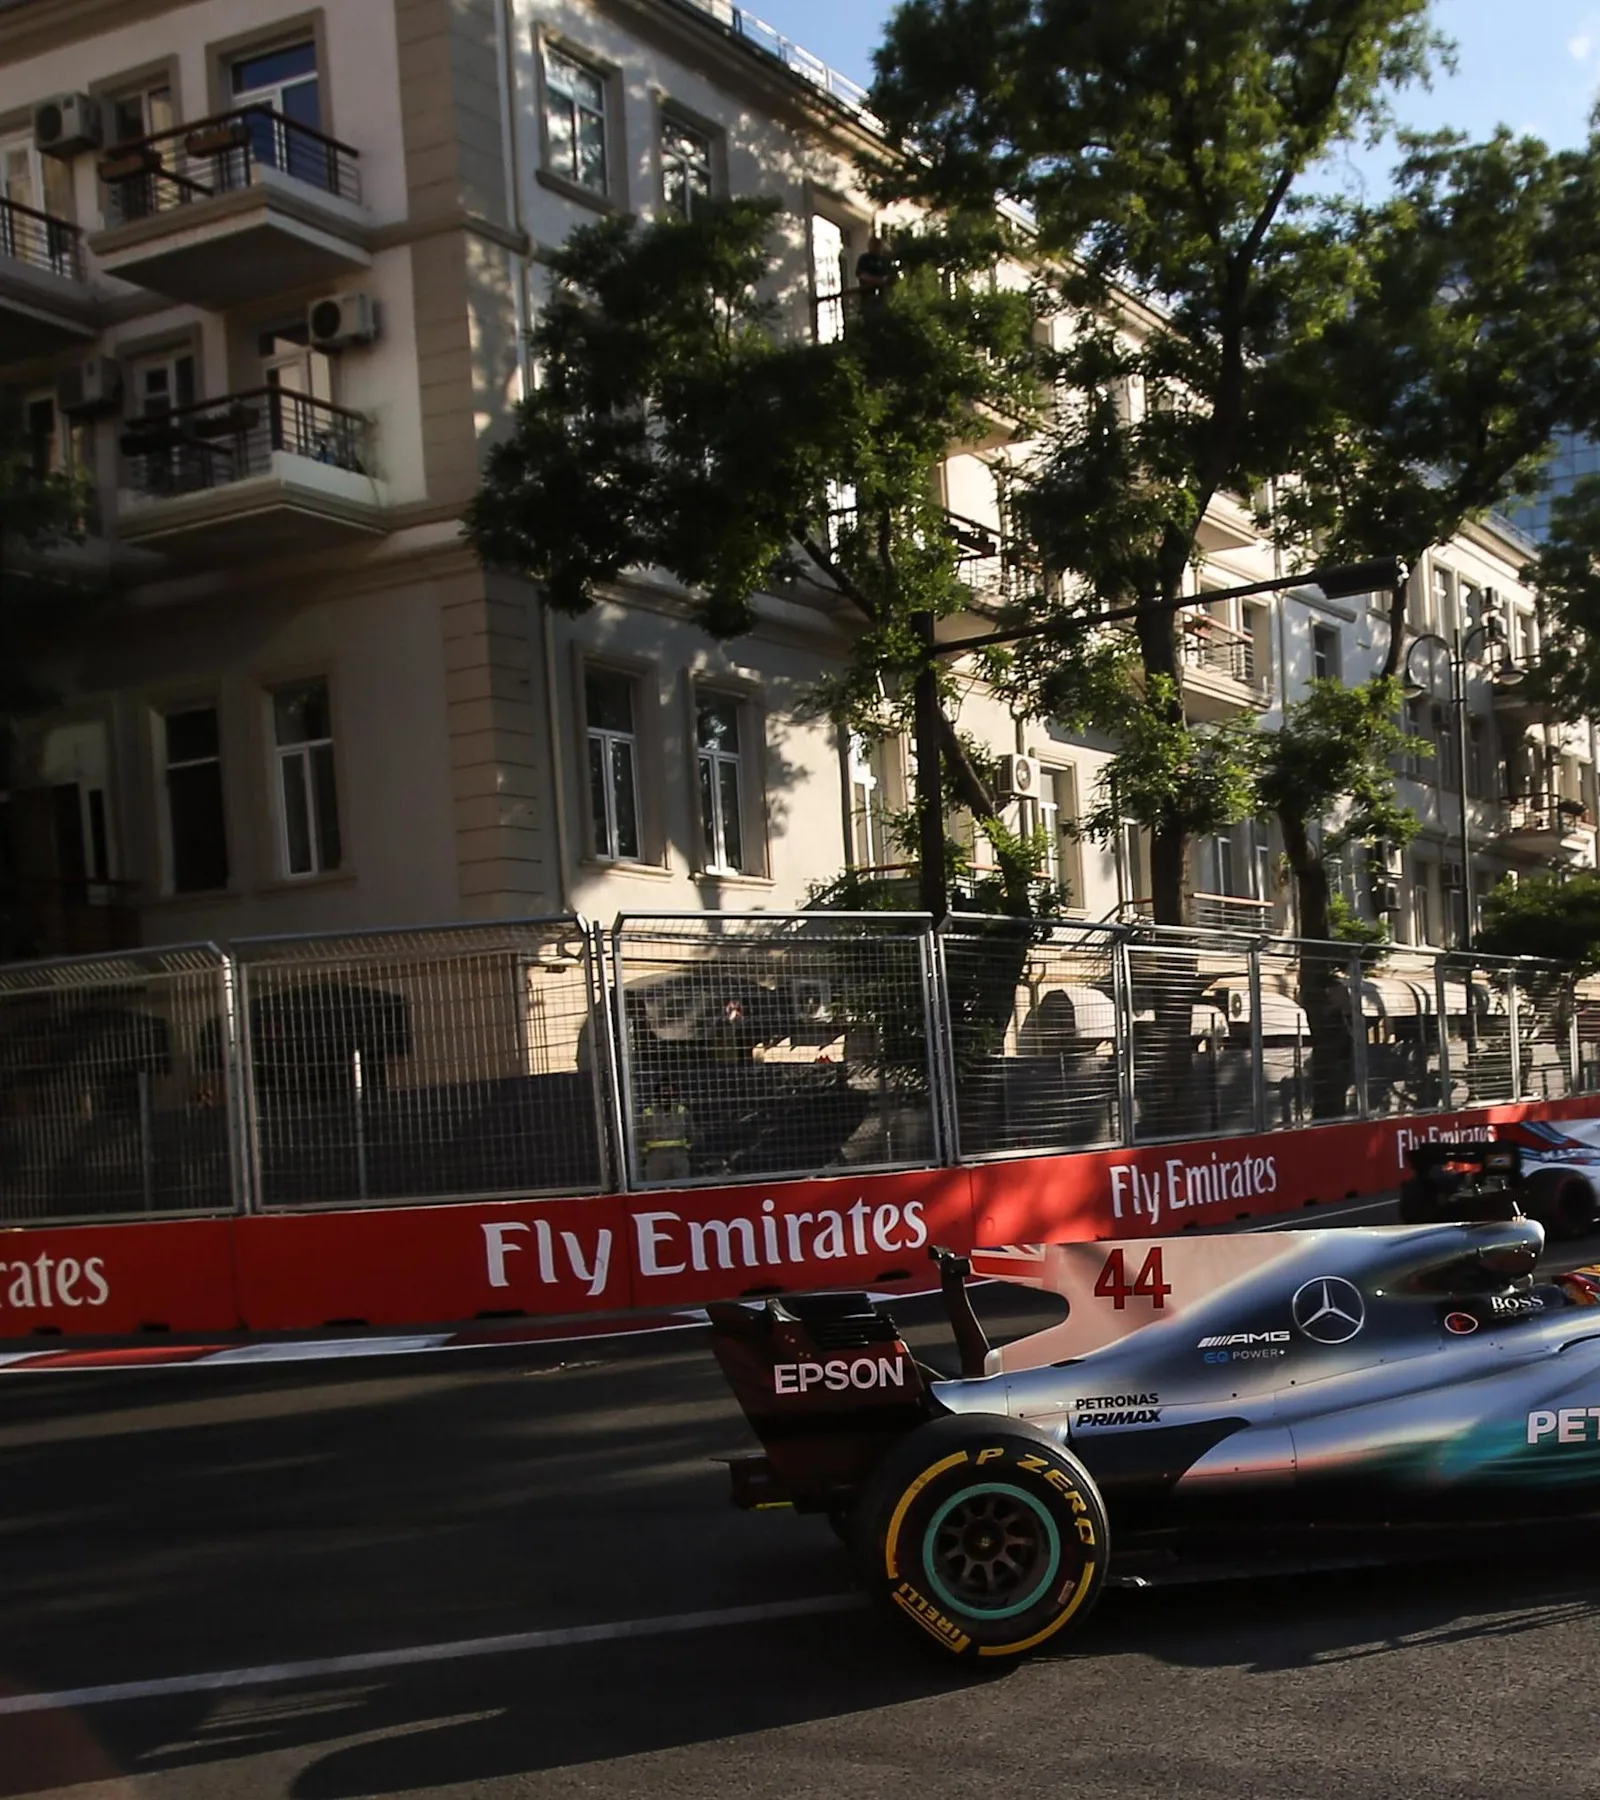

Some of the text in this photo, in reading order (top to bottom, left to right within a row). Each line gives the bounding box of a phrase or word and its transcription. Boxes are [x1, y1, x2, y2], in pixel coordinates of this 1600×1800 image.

[1396, 1127, 1425, 1169] Fl
[1109, 1152, 1277, 1225] Fly Emirates
[480, 1197, 928, 1296] Fly Emirates
[1094, 1246, 1171, 1310] 44
[1490, 1295, 1544, 1310] BOSS
[774, 1356, 905, 1395] EPSON
[1075, 1392, 1160, 1411] PETRONAS
[1075, 1408, 1162, 1428] PRIMAX
[976, 1447, 1096, 1545] P ZERO
[893, 1582, 971, 1653] PIRELLI
